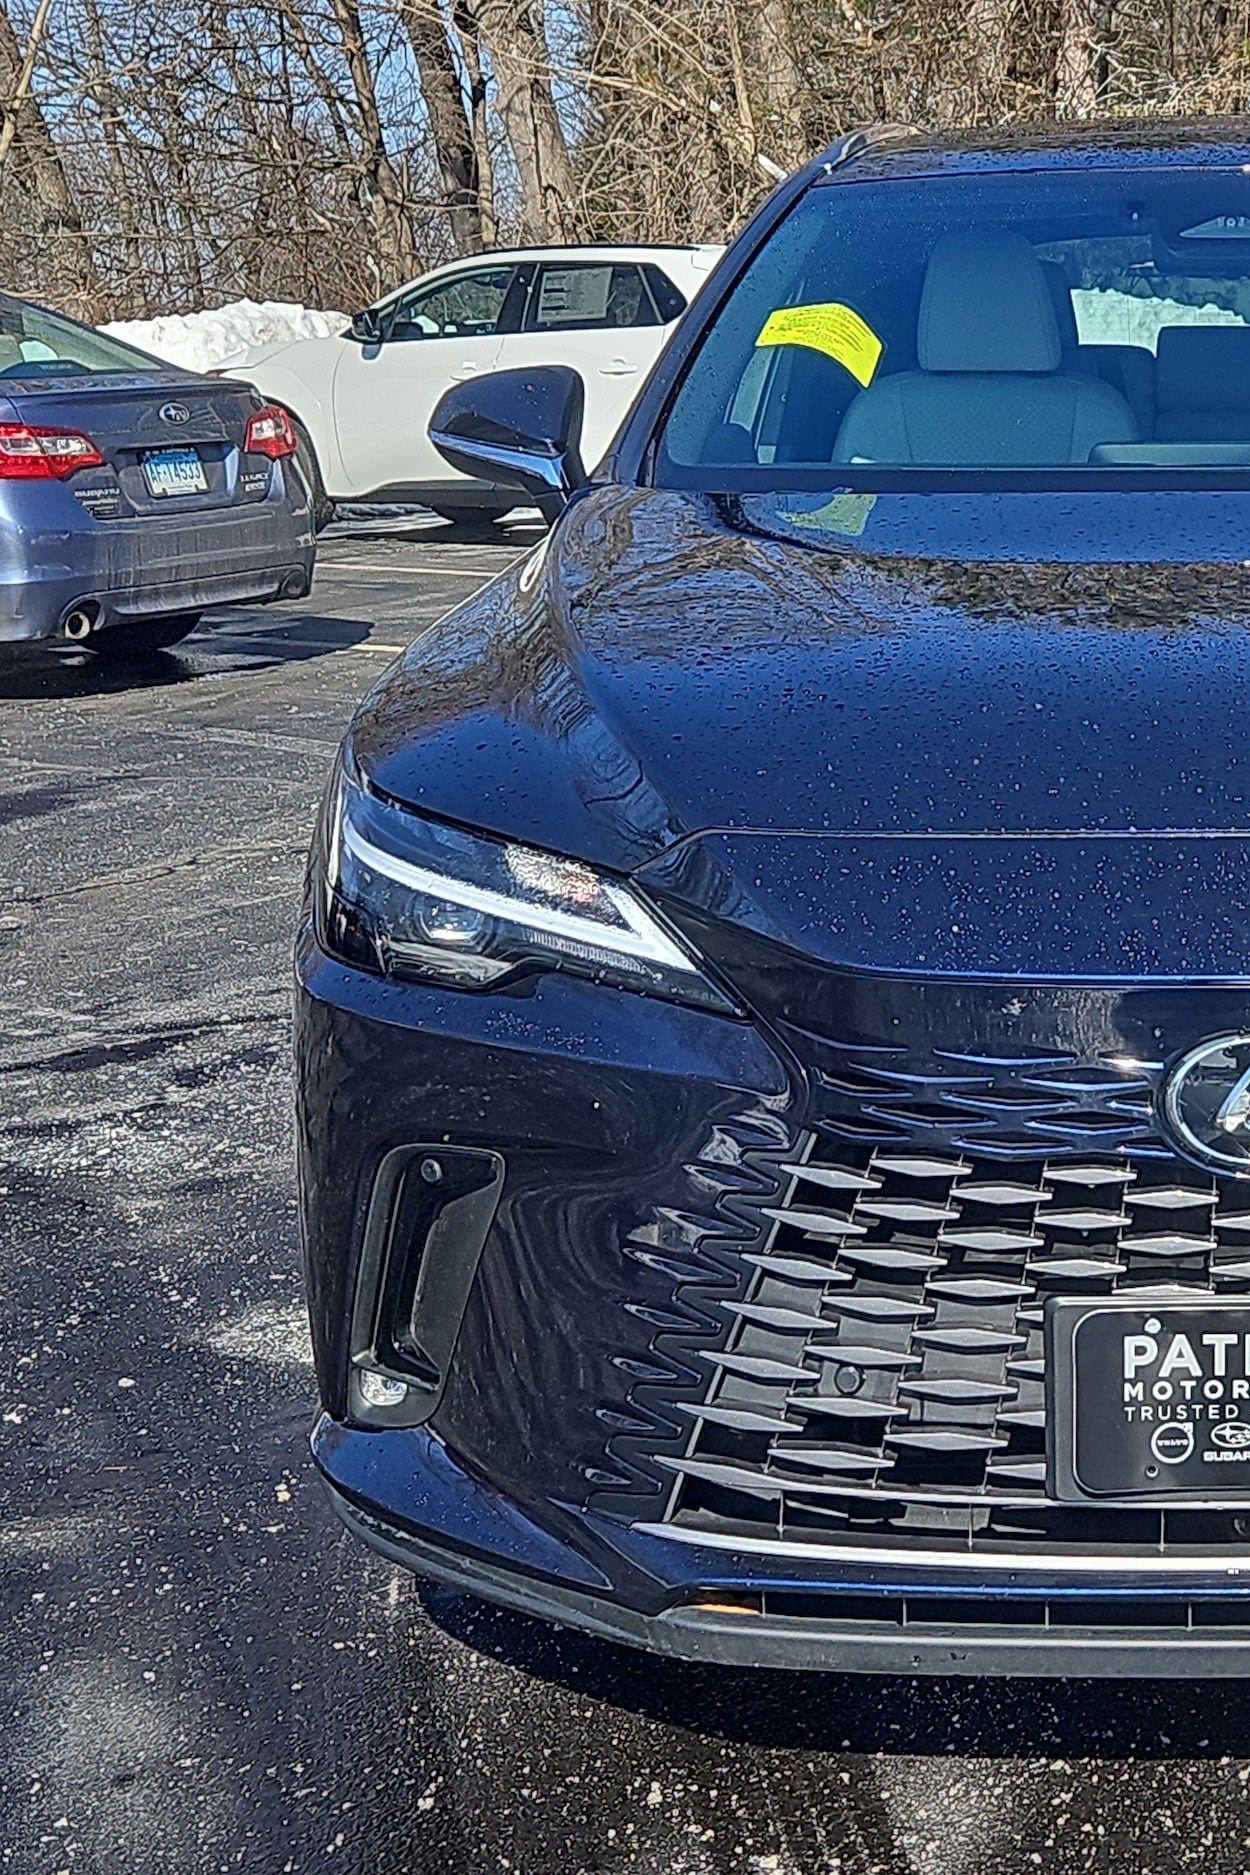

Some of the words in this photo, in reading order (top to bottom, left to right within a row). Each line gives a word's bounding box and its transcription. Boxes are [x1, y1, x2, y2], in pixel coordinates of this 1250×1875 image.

[1124, 1379, 1250, 1402] MOTOR
[1124, 1404, 1239, 1422] TRUSTED
[1156, 1438, 1189, 1448] VOLVO
